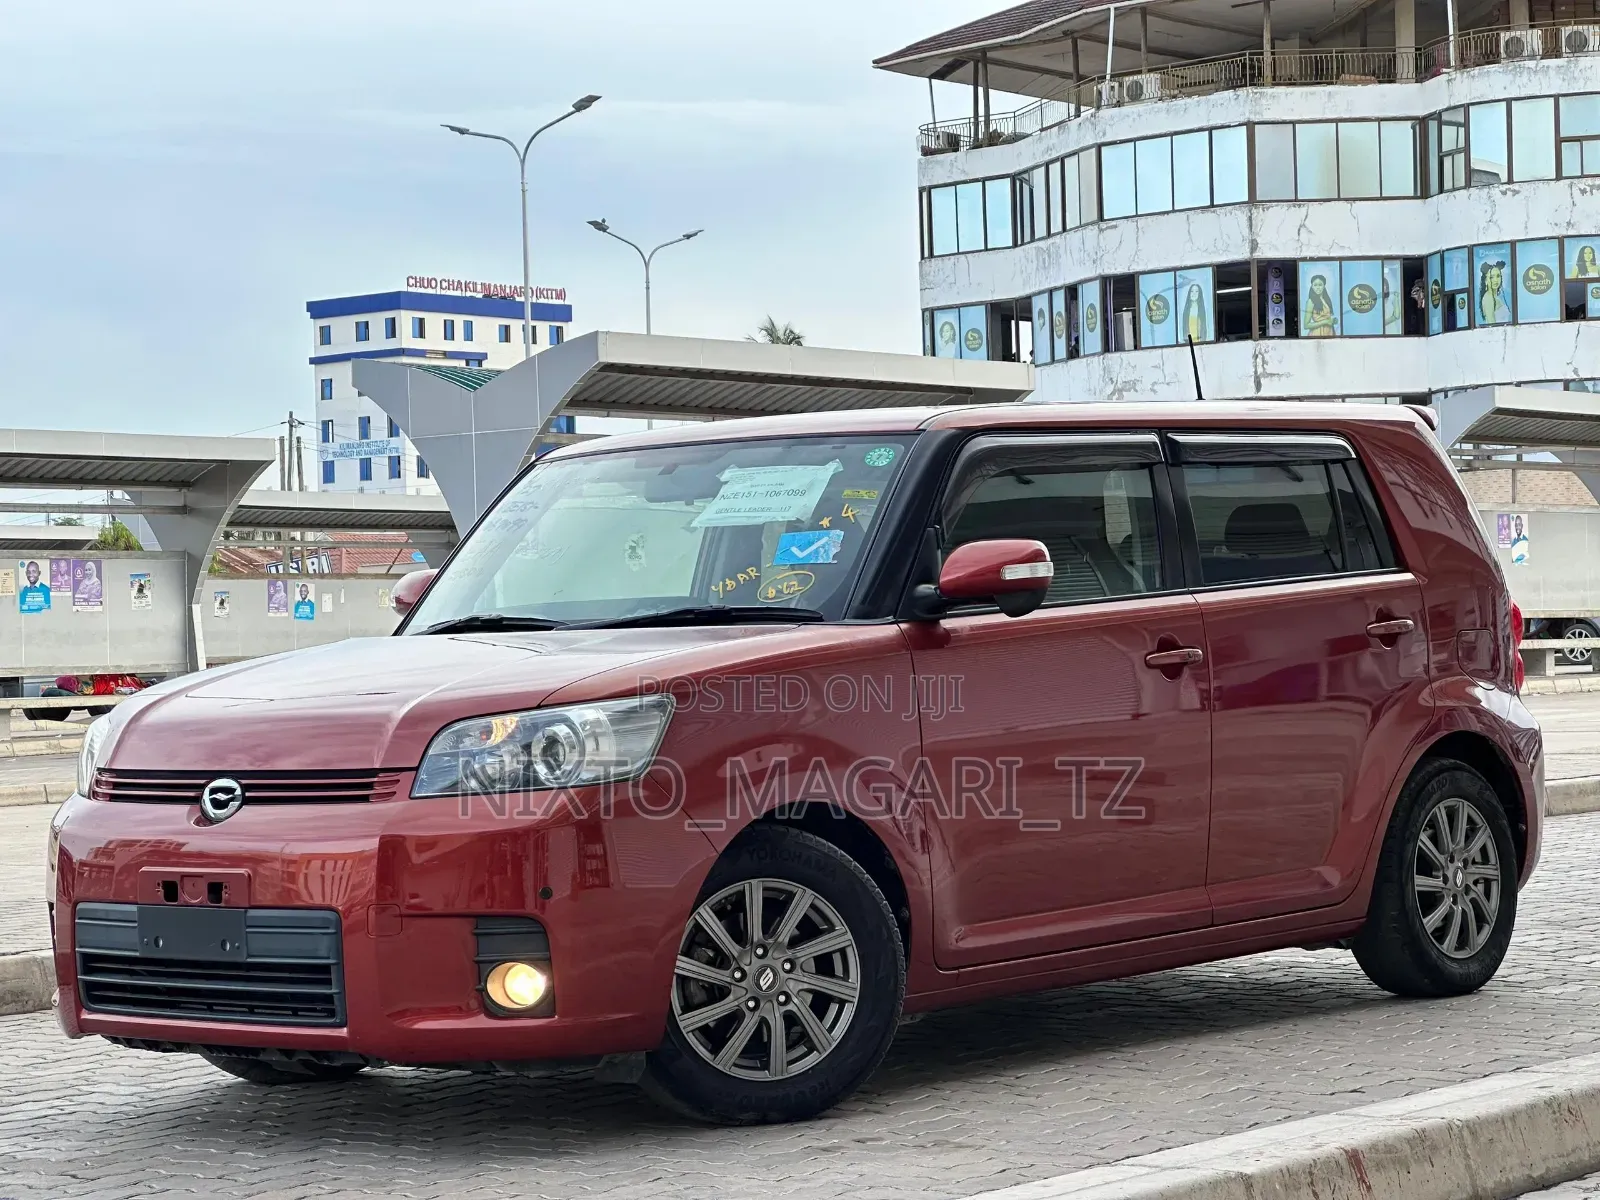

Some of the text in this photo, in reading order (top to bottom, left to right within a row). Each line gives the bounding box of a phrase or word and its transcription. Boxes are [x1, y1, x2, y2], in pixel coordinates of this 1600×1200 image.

[1526, 278, 1551, 286] asnath
[406, 275, 567, 302] CHUO CHA KILIMANJARO (KITM)
[715, 506, 743, 514] GENTLE
